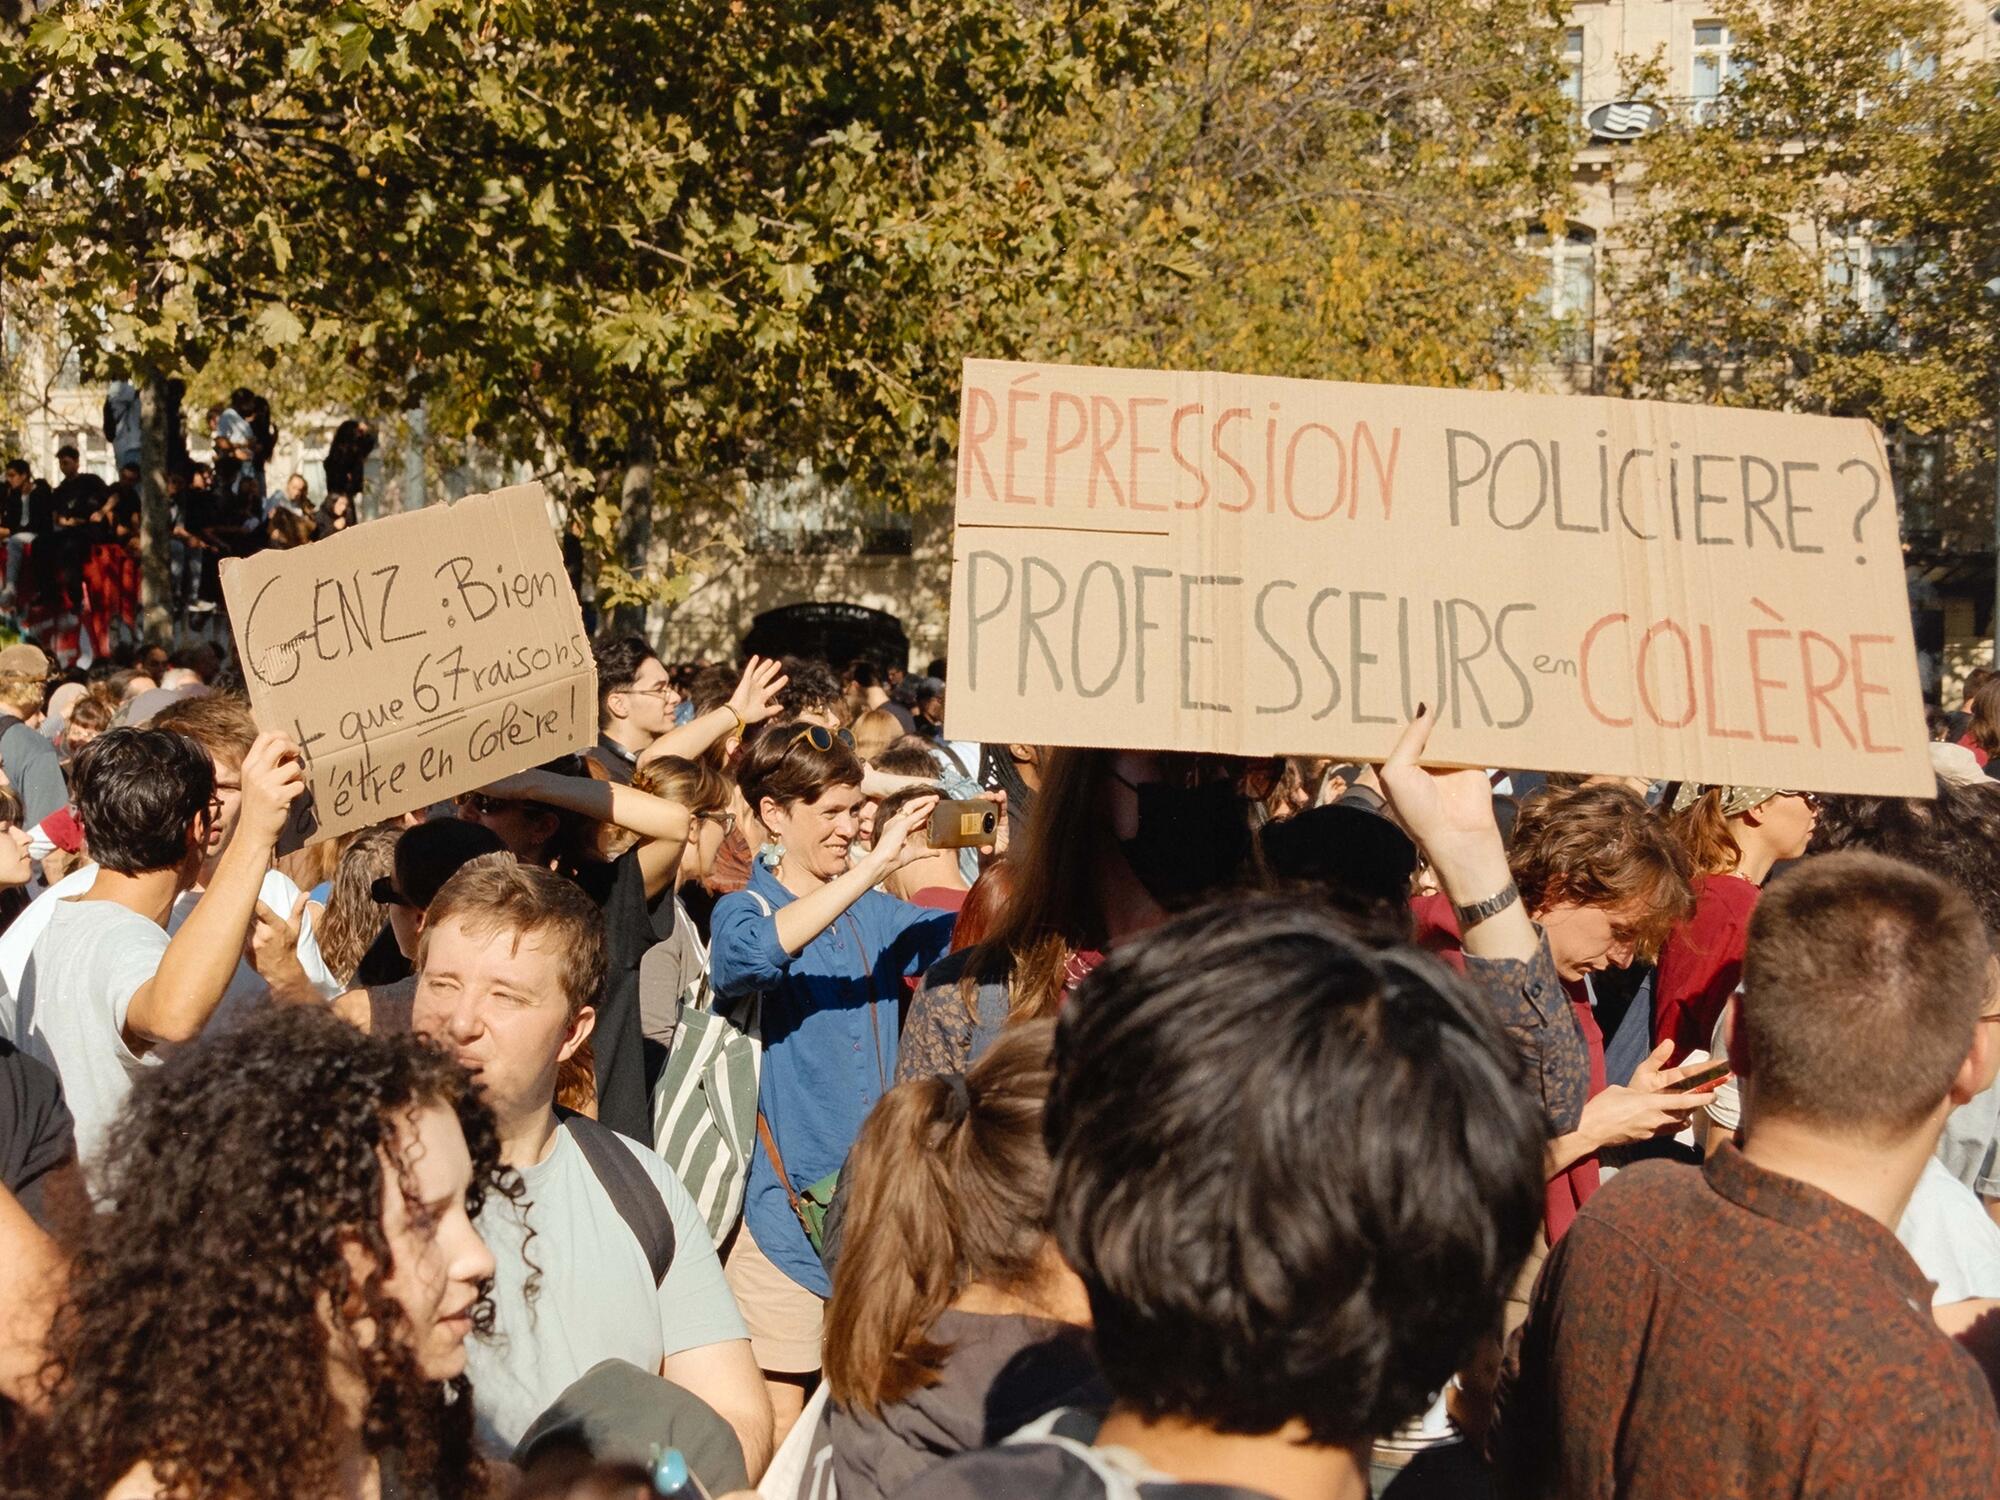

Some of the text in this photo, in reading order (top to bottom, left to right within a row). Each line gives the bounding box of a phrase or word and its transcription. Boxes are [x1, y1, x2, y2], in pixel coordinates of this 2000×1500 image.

[434, 555, 557, 623] Bien
[967, 549, 1904, 755] PROFESSEURS en COLÈRE
[340, 697, 405, 787] que
[420, 746, 453, 782] en
